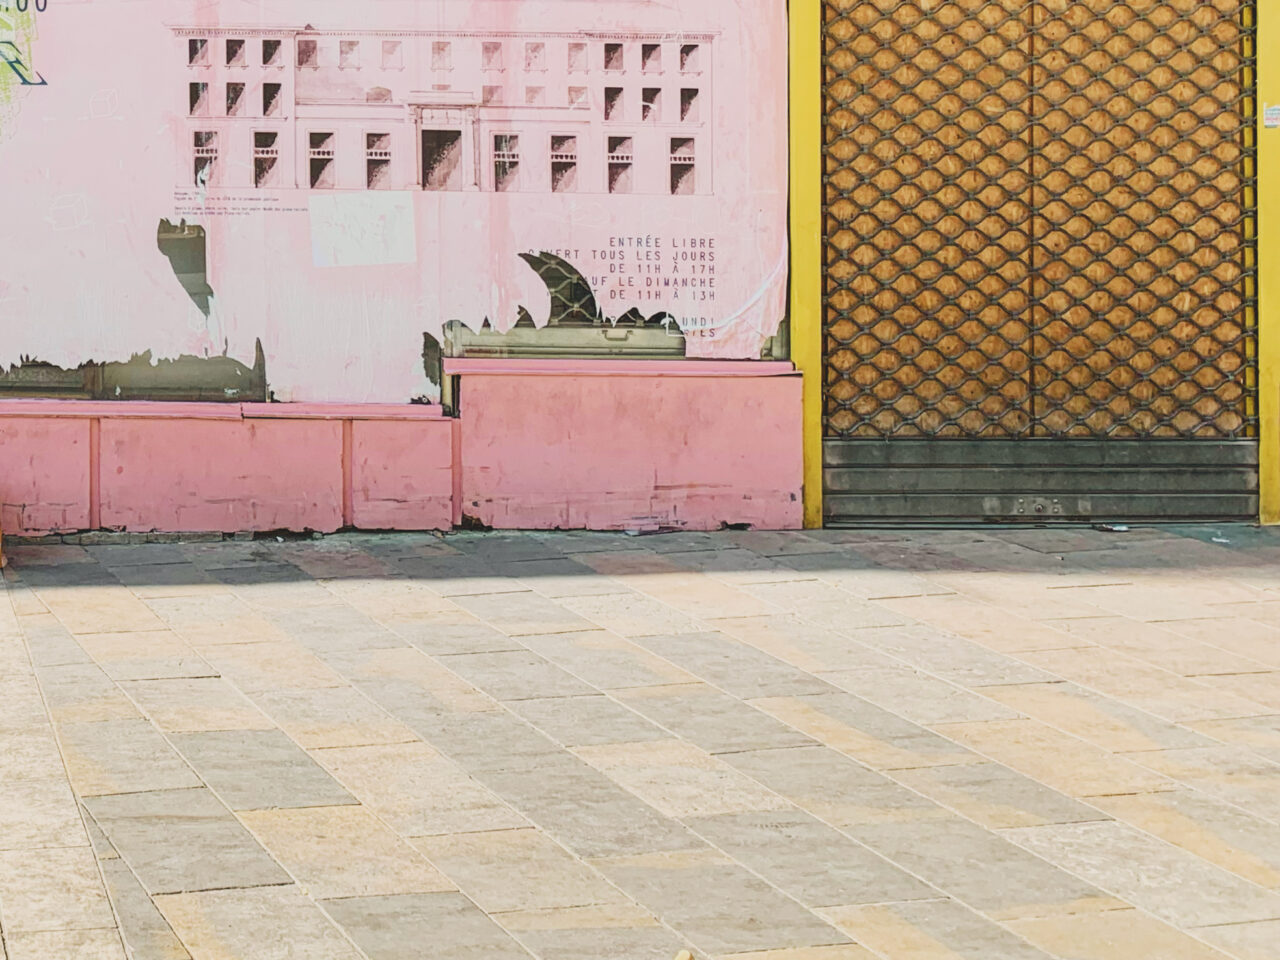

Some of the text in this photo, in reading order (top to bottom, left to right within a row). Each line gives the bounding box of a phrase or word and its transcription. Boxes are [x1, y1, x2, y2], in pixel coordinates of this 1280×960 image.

[609, 235, 715, 249] ENTRÉE LIBRE
[591, 249, 625, 260] TOUS
[636, 250, 661, 261] LES
[672, 251, 715, 262] JOURS
[609, 261, 715, 275] DE 11H À 17H
[584, 276, 715, 288] UF LE DIMANCHE
[609, 289, 625, 300] DE
[637, 290, 661, 300] 11H
[672, 287, 679, 300] À
[692, 291, 715, 301] 13H
